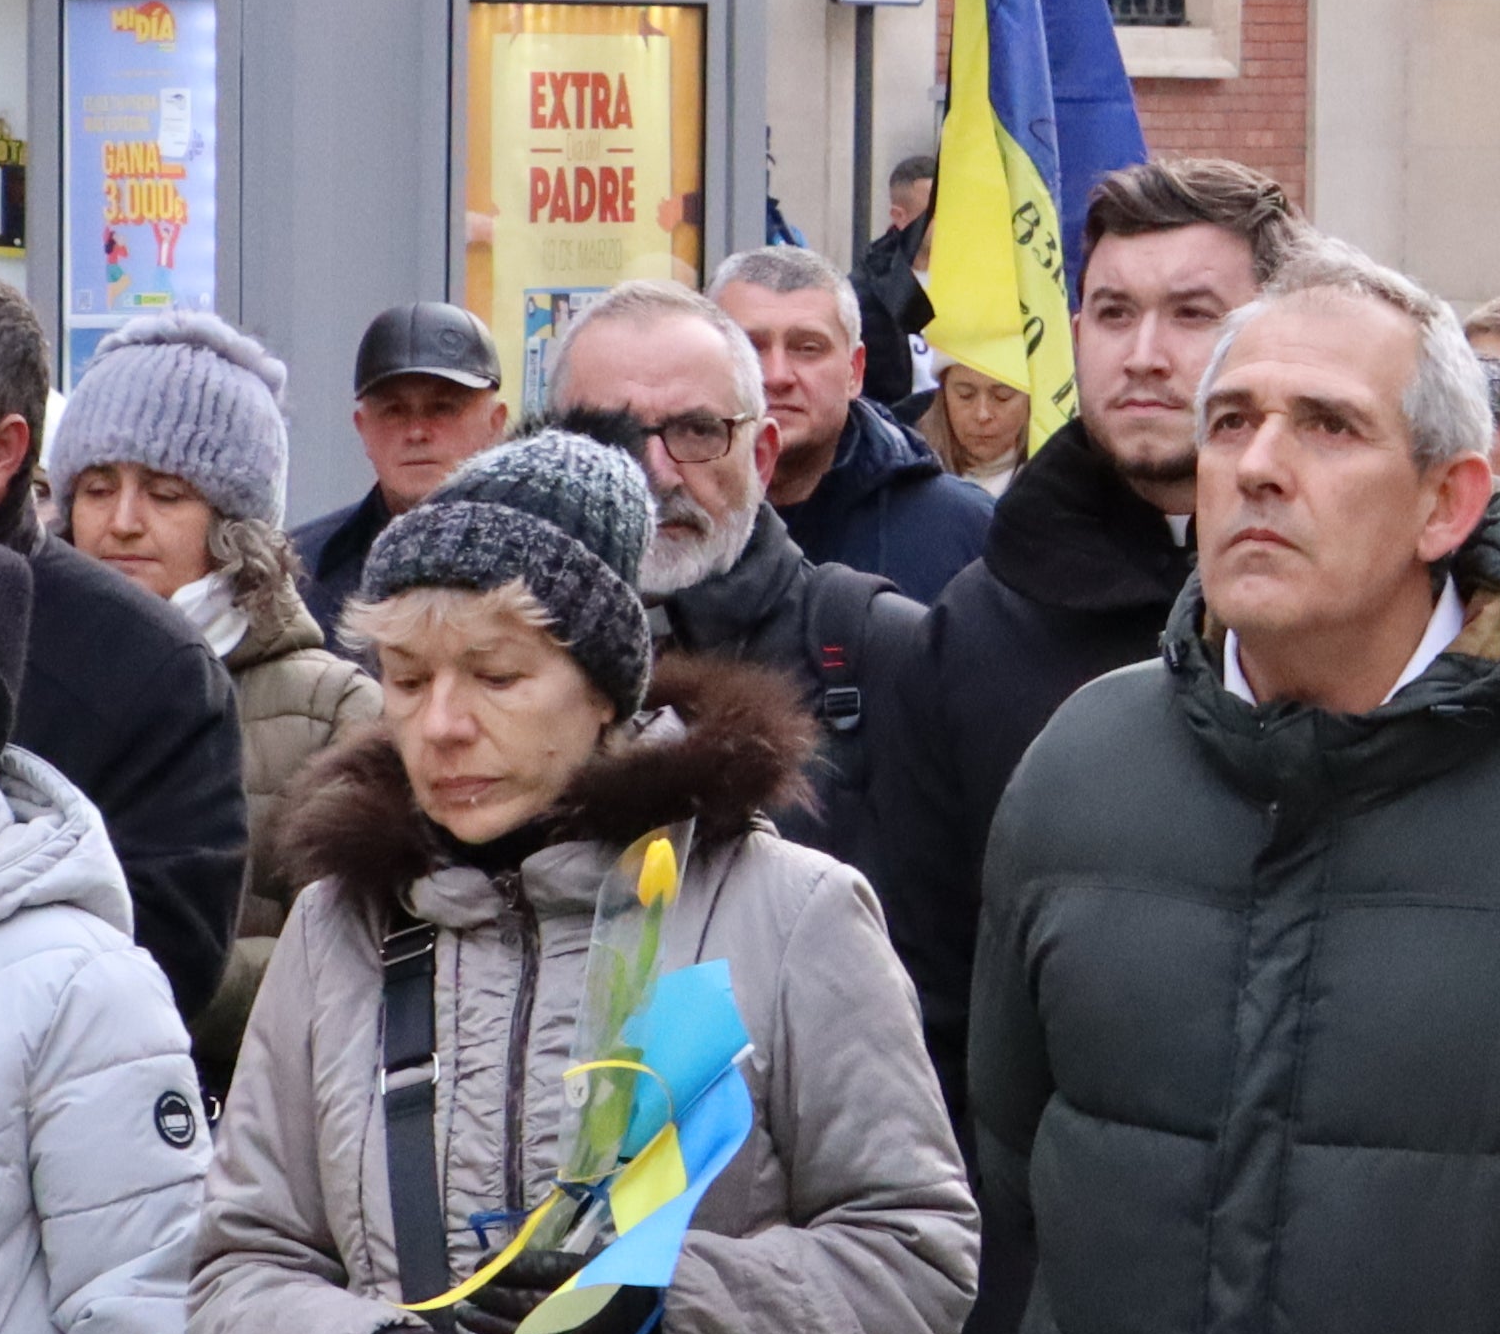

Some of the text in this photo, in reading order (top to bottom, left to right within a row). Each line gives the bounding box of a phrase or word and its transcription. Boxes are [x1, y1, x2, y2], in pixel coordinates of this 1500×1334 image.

[530, 72, 633, 130] EXTRA
[104, 141, 161, 177] GANA
[529, 166, 635, 223] PADRE
